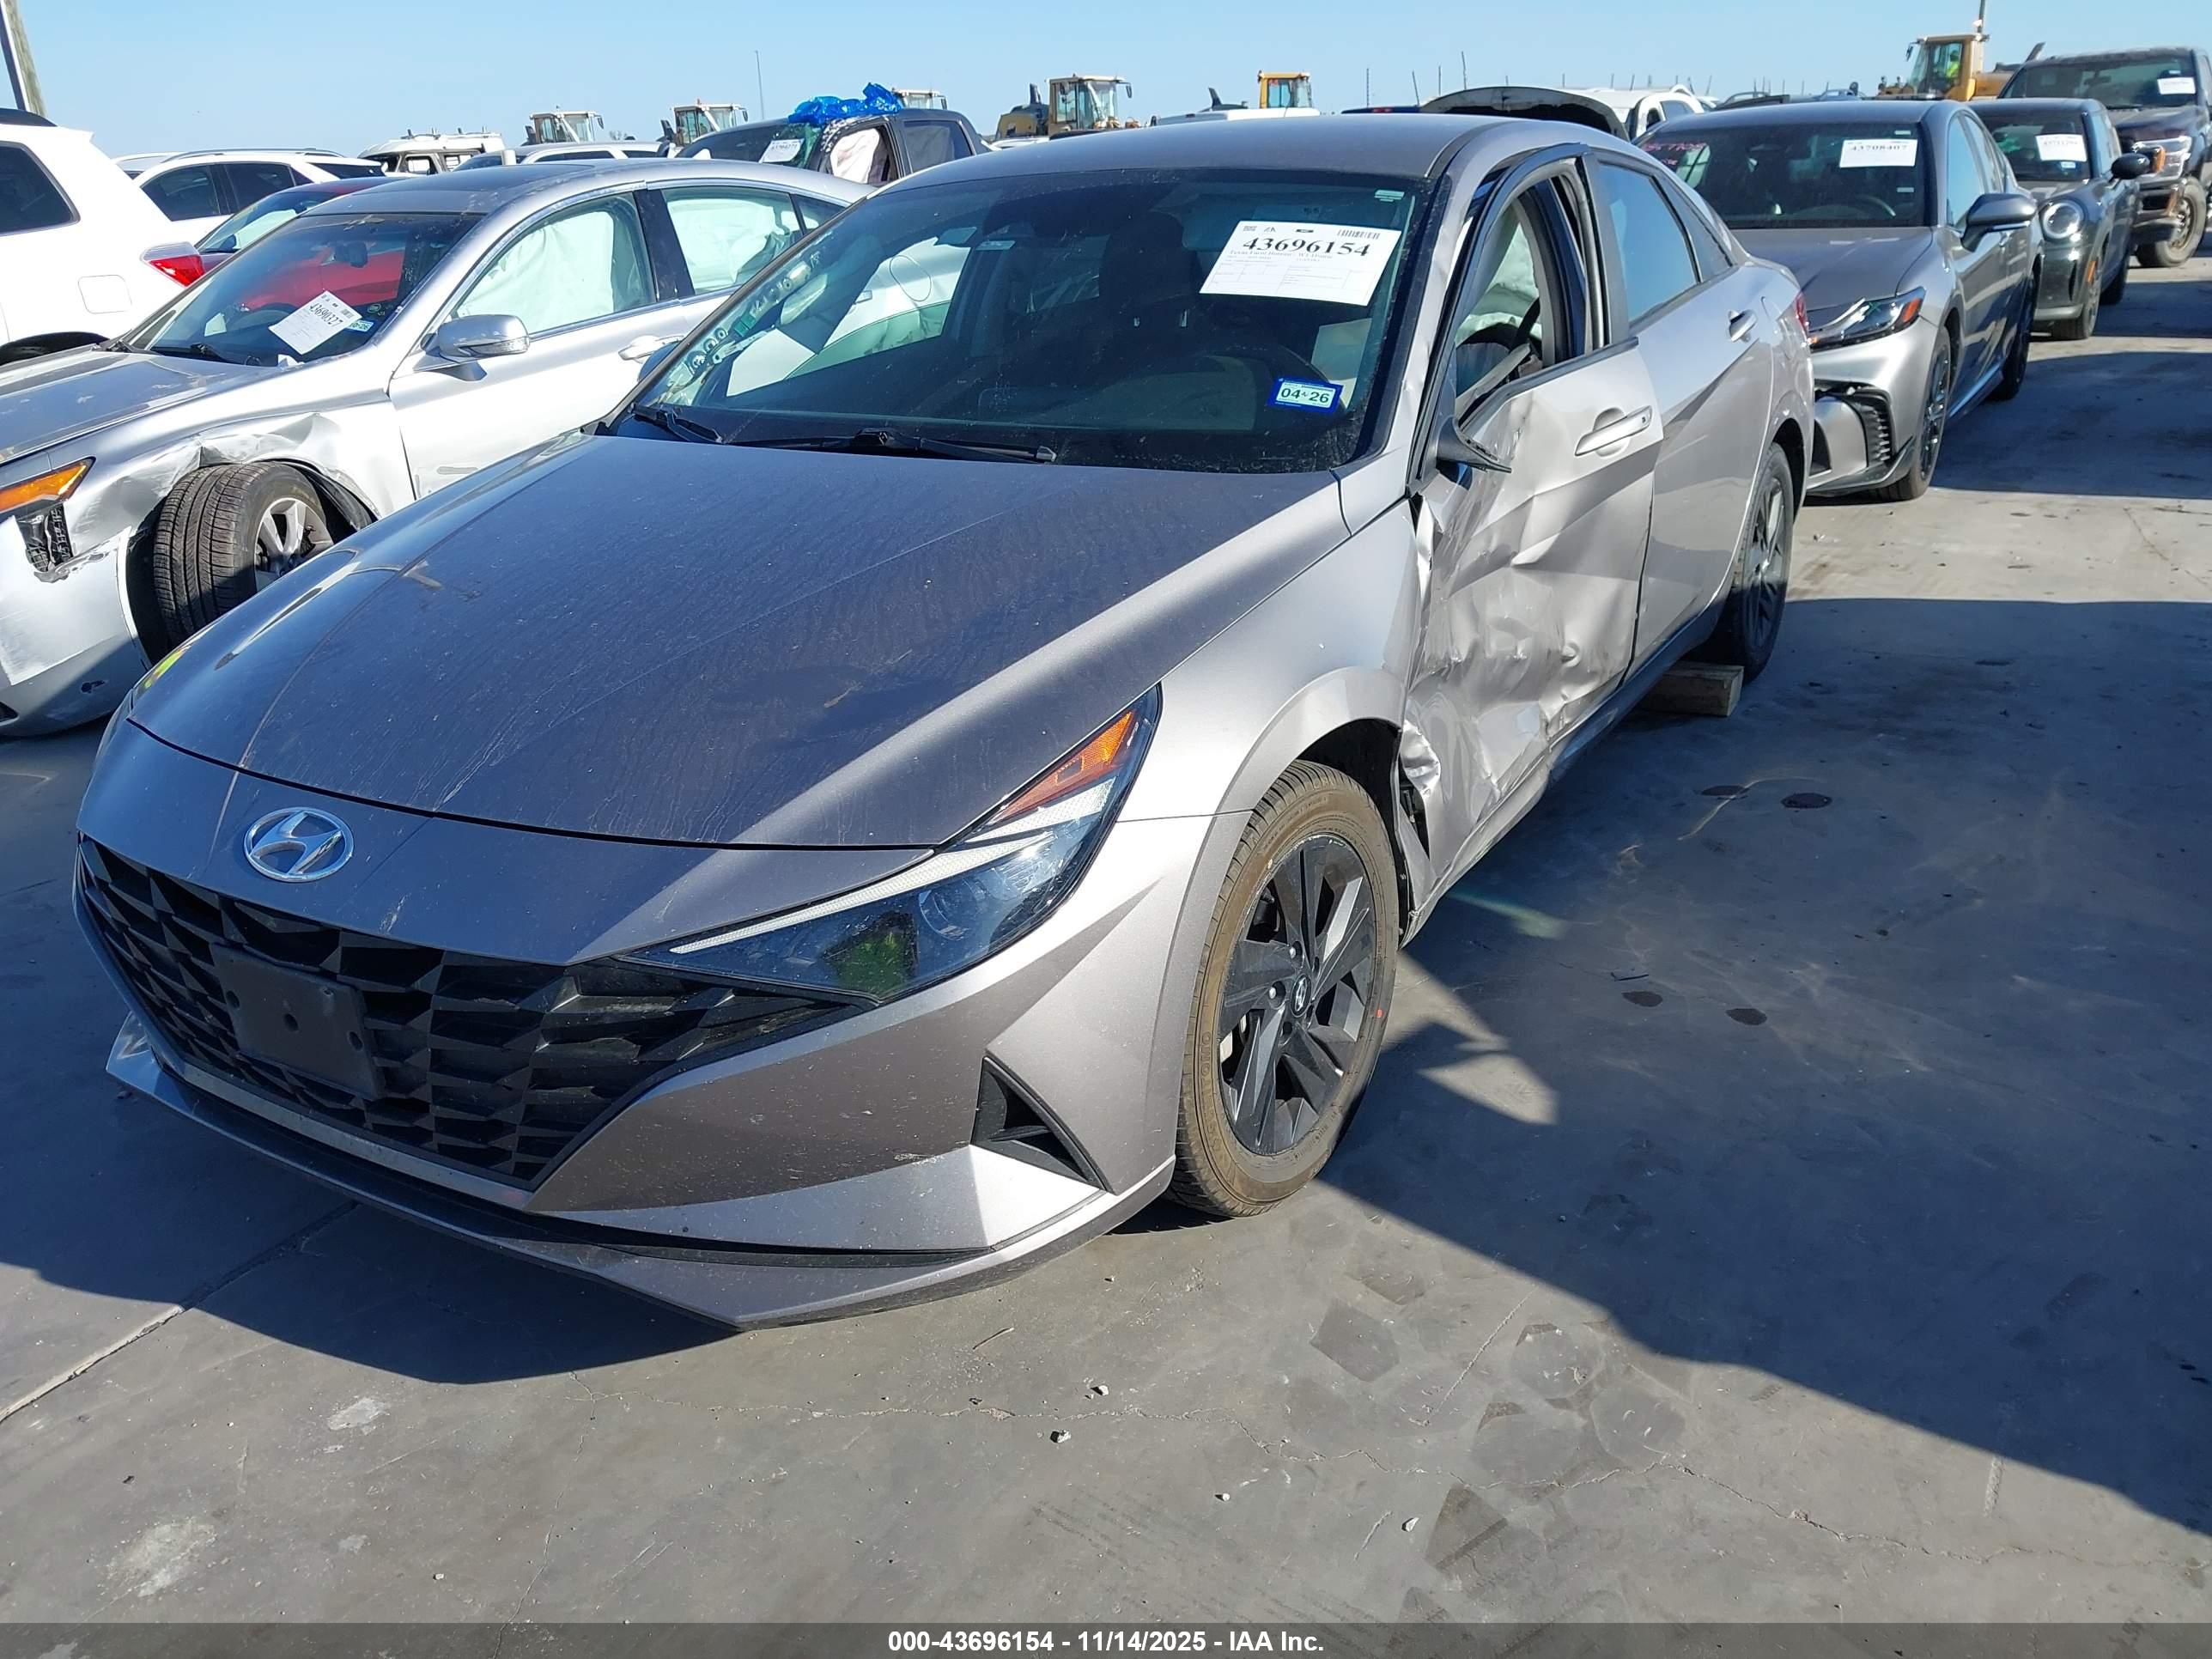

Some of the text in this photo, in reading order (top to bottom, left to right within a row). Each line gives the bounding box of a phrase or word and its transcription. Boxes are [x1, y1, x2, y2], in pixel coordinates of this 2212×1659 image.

[1243, 237, 1371, 257] 43696154
[310, 303, 343, 326] 43690327
[1280, 387, 1301, 399] 04
[1309, 391, 1330, 404] 26
